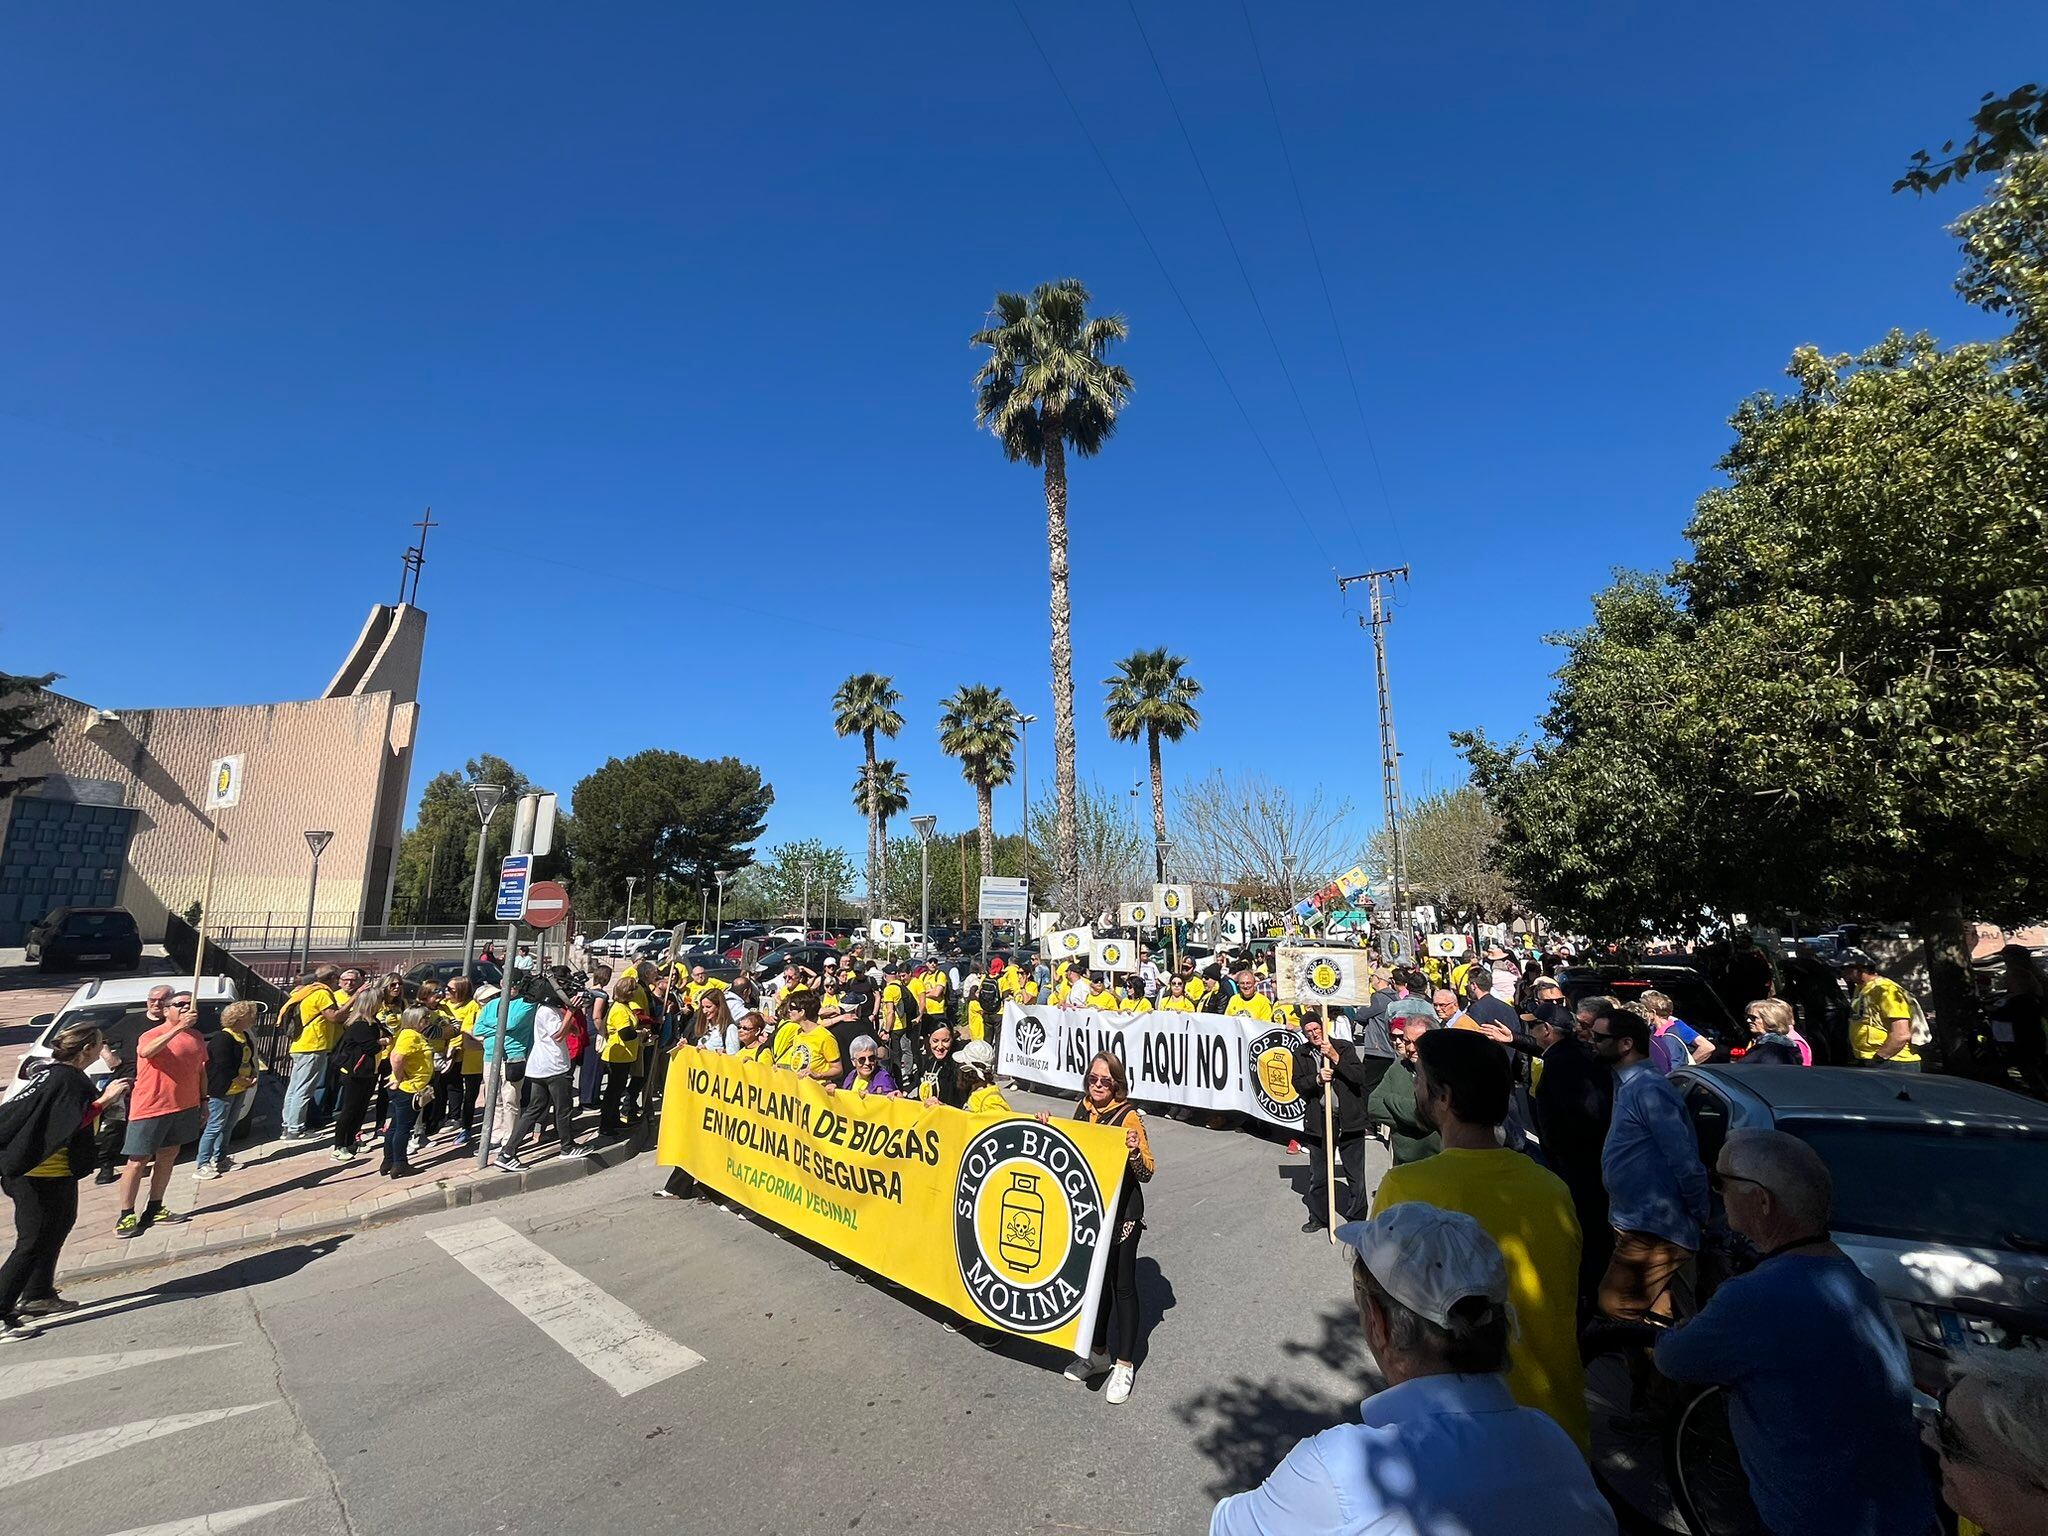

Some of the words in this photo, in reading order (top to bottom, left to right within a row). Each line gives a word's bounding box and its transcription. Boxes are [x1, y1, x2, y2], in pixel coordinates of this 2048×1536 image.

[1005, 1053, 1014, 1063] LA
[1017, 1055, 1049, 1071] POLVORISTA
[1142, 1020, 1189, 1088] AQUÍ
[1197, 1034, 1228, 1091] NO
[1250, 1037, 1270, 1073] STOP
[688, 1067, 709, 1094] NO
[711, 1075, 721, 1099] A
[723, 1078, 744, 1107] LA
[748, 1084, 811, 1133] PLANTA
[813, 1109, 848, 1146] DE
[848, 1120, 940, 1166] BIOGÁS
[1257, 1090, 1307, 1118] MOLINA
[702, 1107, 723, 1135] EN
[725, 1115, 789, 1161] MOLINA
[794, 1138, 811, 1174] DE
[813, 1151, 902, 1204] SEGURA
[958, 1138, 999, 1219] STOP
[1021, 1130, 1097, 1247] BIOGÁS
[726, 1157, 802, 1205] PLATAFORMA
[806, 1189, 858, 1231] VECINAL
[966, 1257, 1080, 1321] MOLINA
